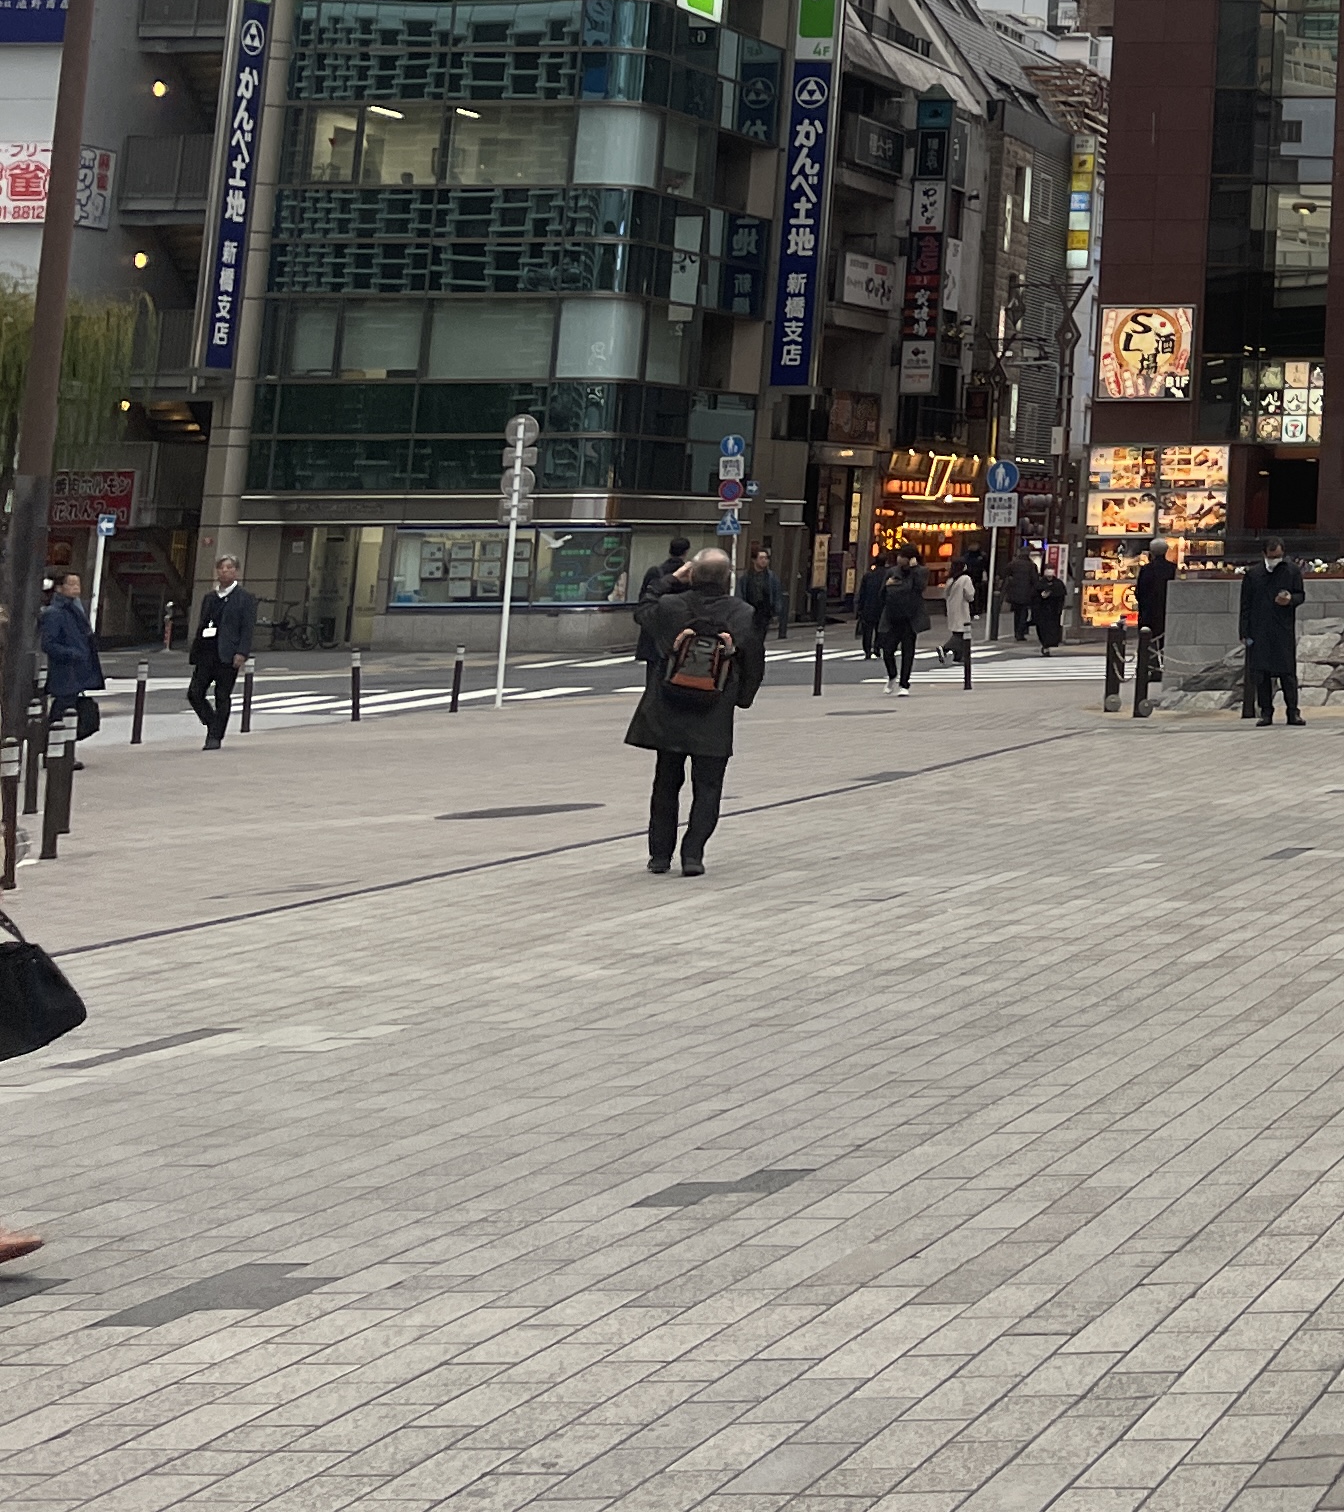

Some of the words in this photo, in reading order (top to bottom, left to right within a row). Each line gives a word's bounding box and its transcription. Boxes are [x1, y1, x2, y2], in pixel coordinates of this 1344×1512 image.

[812, 41, 831, 57] 4F
[225, 67, 259, 223] かんべ土地
[785, 118, 824, 257] かんべ土地
[211, 240, 239, 346] 新橋支店
[780, 272, 808, 367] 新橋支店
